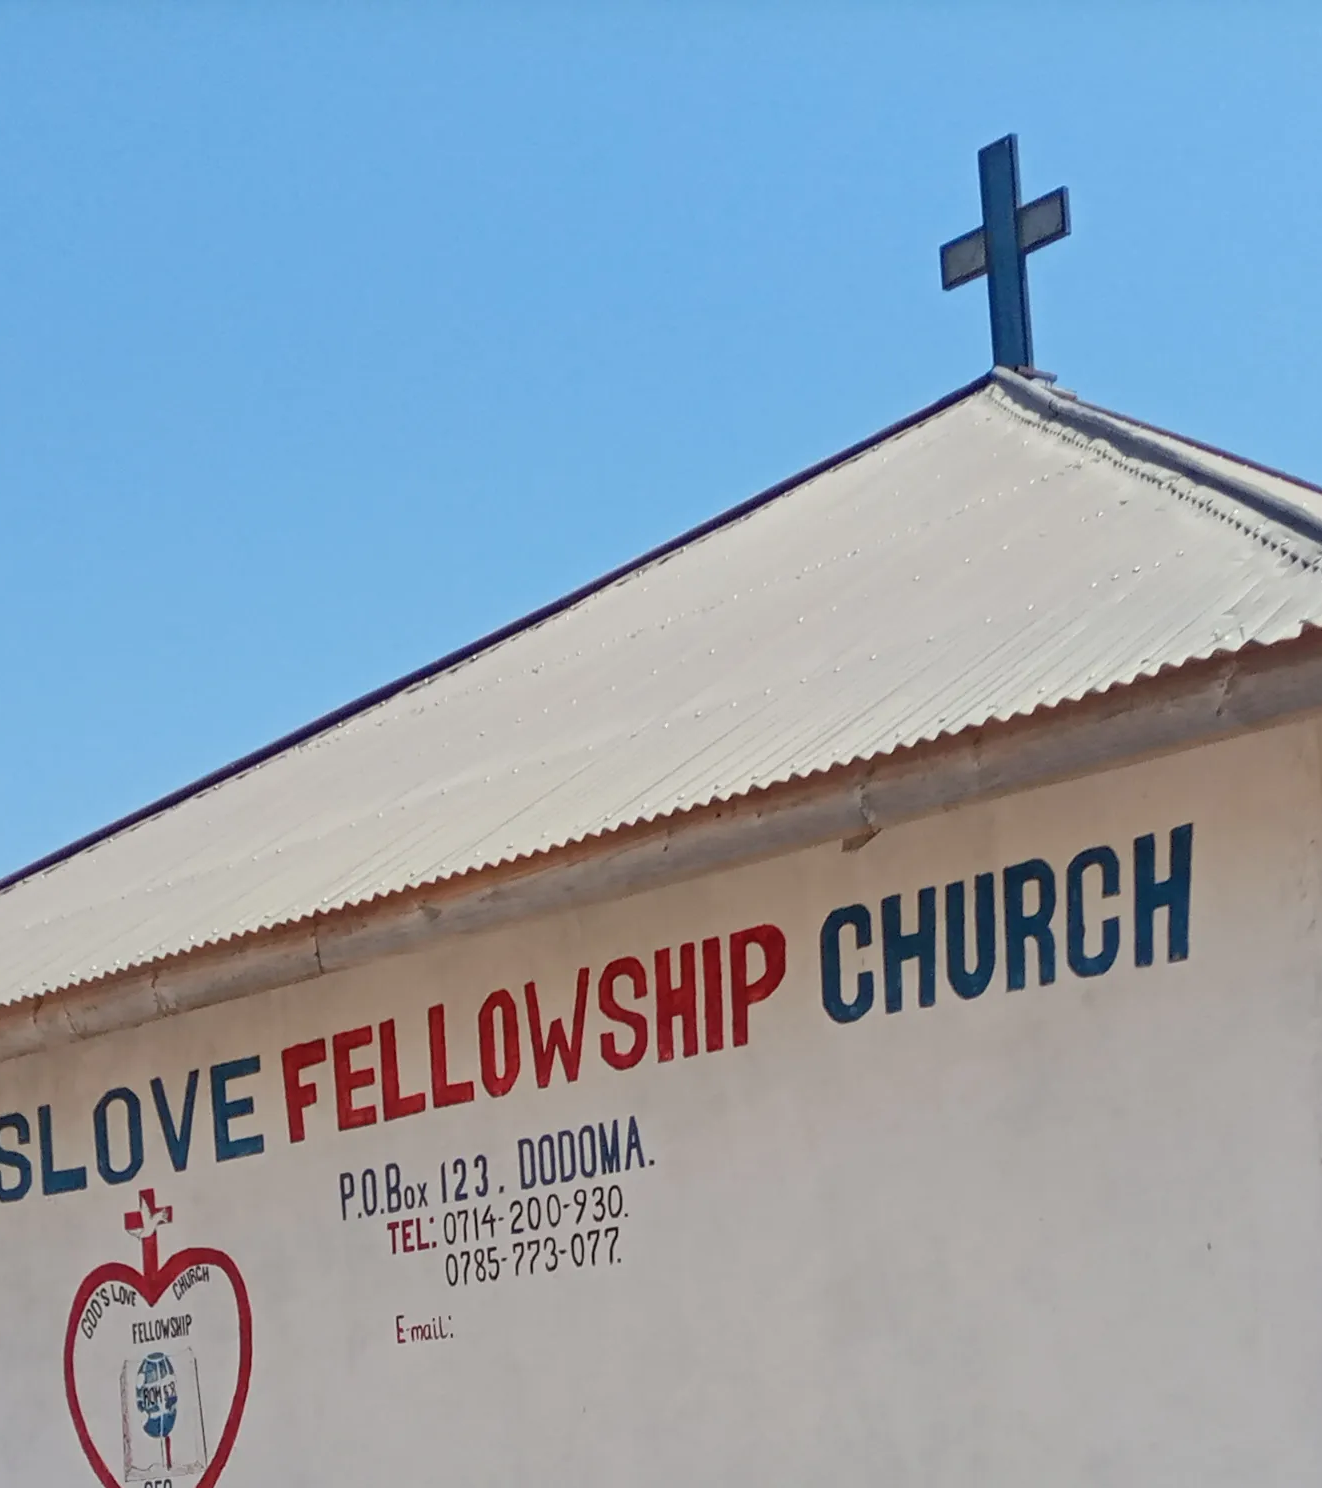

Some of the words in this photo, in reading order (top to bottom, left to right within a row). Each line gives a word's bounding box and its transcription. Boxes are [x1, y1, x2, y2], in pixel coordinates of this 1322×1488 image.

[280, 923, 787, 1144] FELLOWSHIP
[819, 822, 1194, 1025] CHURCH
[517, 1114, 656, 1191] DODOMA.
[386, 1216, 438, 1255] TEL:
[442, 1184, 629, 1246] 0714-200-930.
[171, 1264, 211, 1302] CHURCH
[444, 1225, 623, 1287] 0785-773-077.
[80, 1286, 111, 1340] GOD'S
[110, 1283, 137, 1308] LOVE
[131, 1313, 193, 1345] FELLOWSHIP
